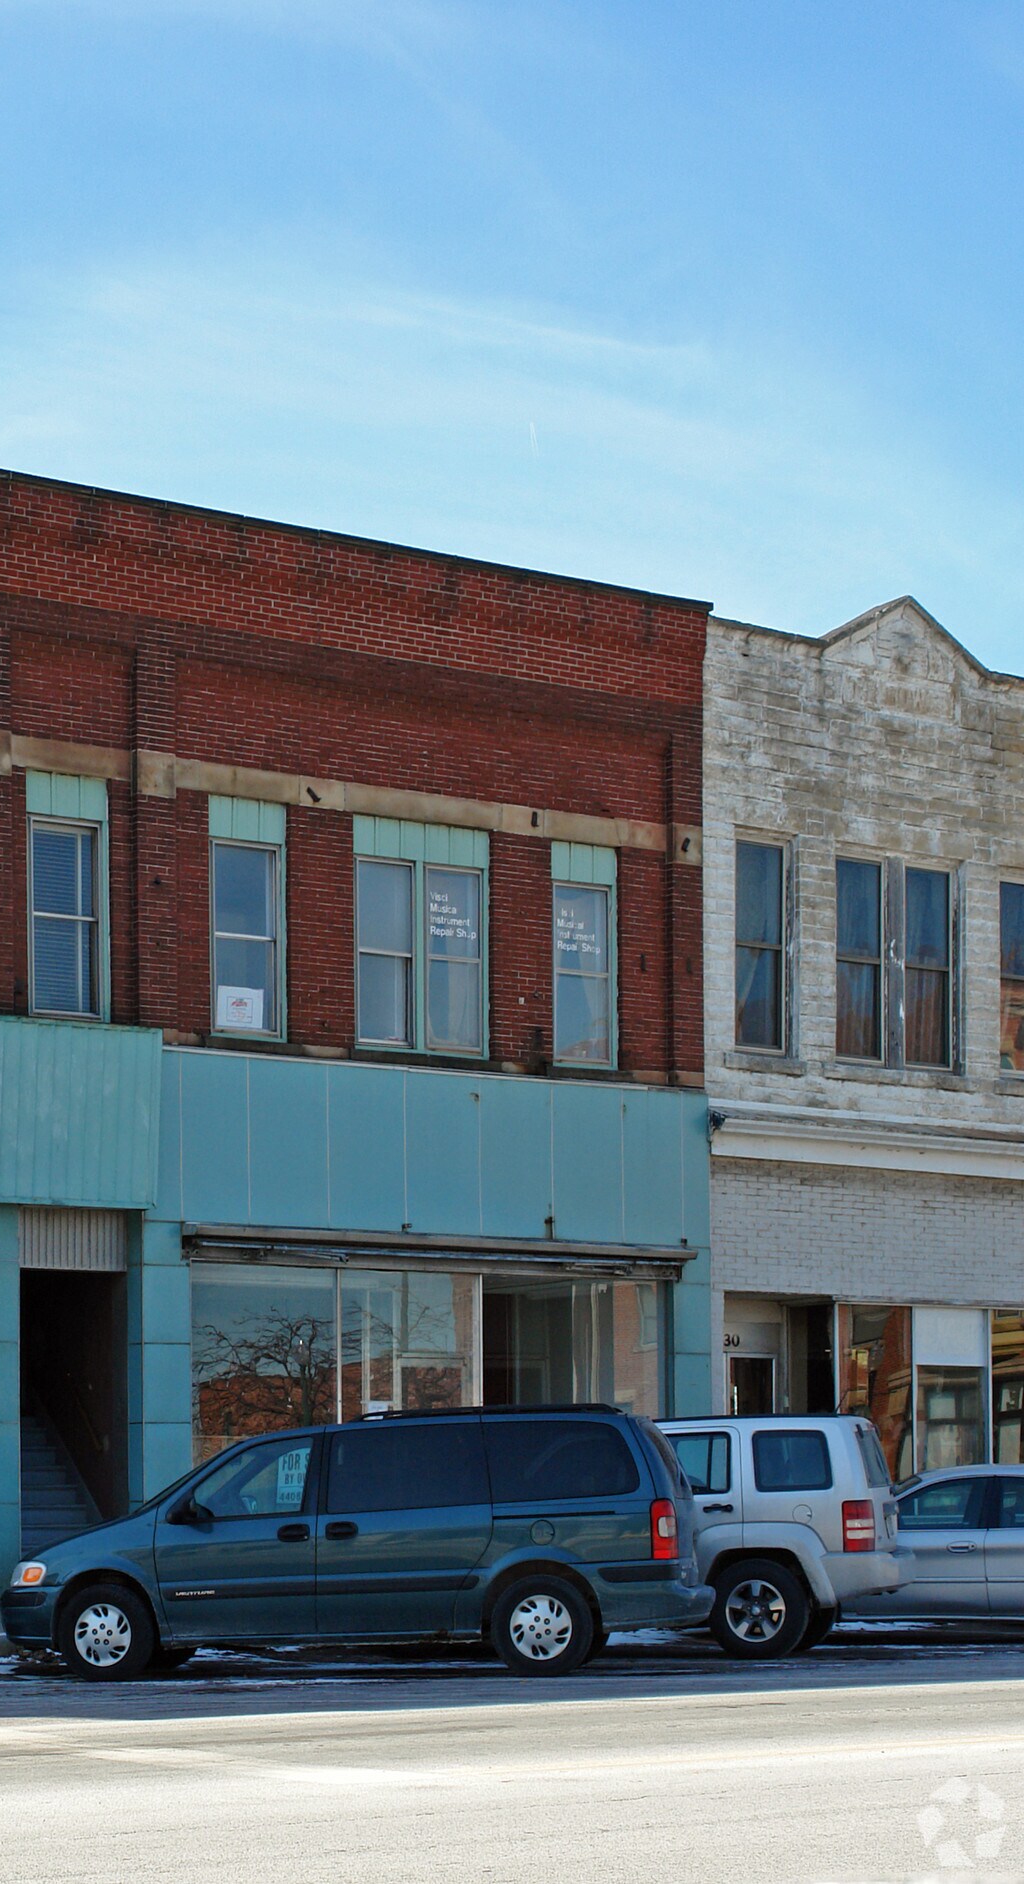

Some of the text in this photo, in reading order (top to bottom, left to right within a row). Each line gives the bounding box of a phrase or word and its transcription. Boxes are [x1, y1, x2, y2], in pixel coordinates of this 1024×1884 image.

[723, 1333, 740, 1347] 30
[282, 1454, 300, 1471] FOR
[284, 1473, 294, 1485] BY
